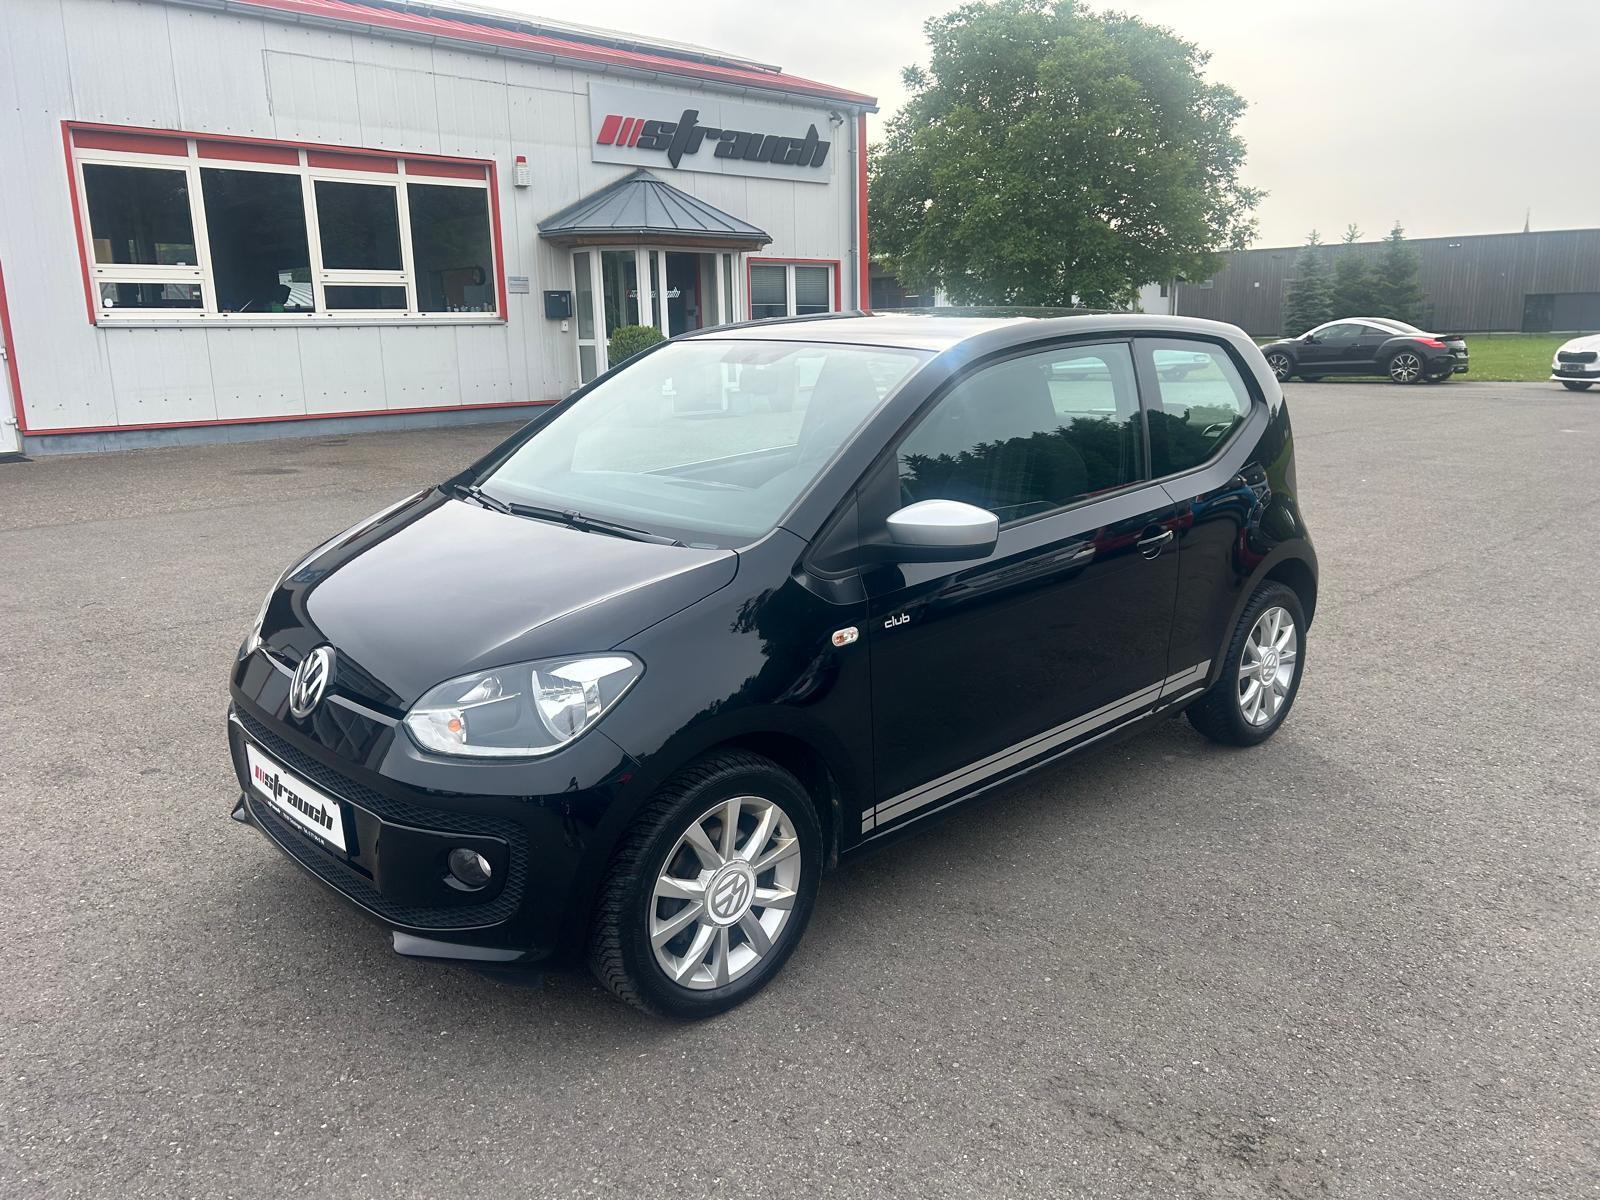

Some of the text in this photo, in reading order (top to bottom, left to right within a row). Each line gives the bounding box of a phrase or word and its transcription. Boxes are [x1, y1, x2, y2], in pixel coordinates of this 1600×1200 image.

[636, 109, 831, 169] strauch
[884, 613, 911, 629] club
[264, 773, 334, 831] strauch
